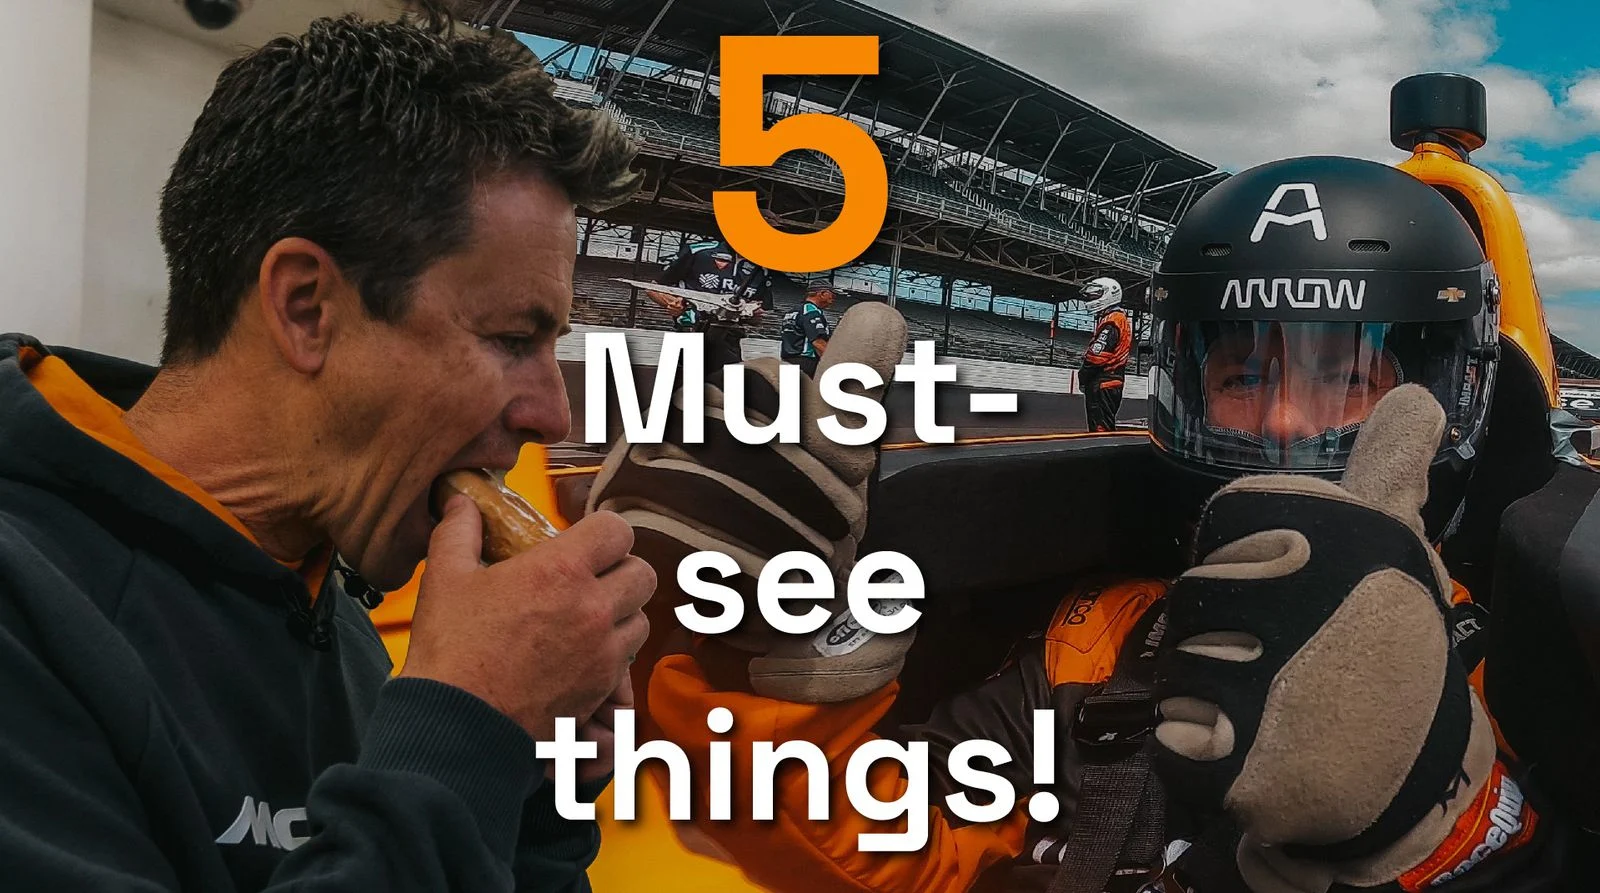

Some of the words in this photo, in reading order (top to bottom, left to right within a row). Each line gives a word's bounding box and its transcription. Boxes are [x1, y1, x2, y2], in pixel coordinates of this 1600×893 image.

[1250, 183, 1327, 243] A
[722, 278, 757, 298] RFF
[1220, 279, 1366, 310] ARROW
[1149, 610, 1168, 648] IMP
[1452, 618, 1482, 648] ACT
